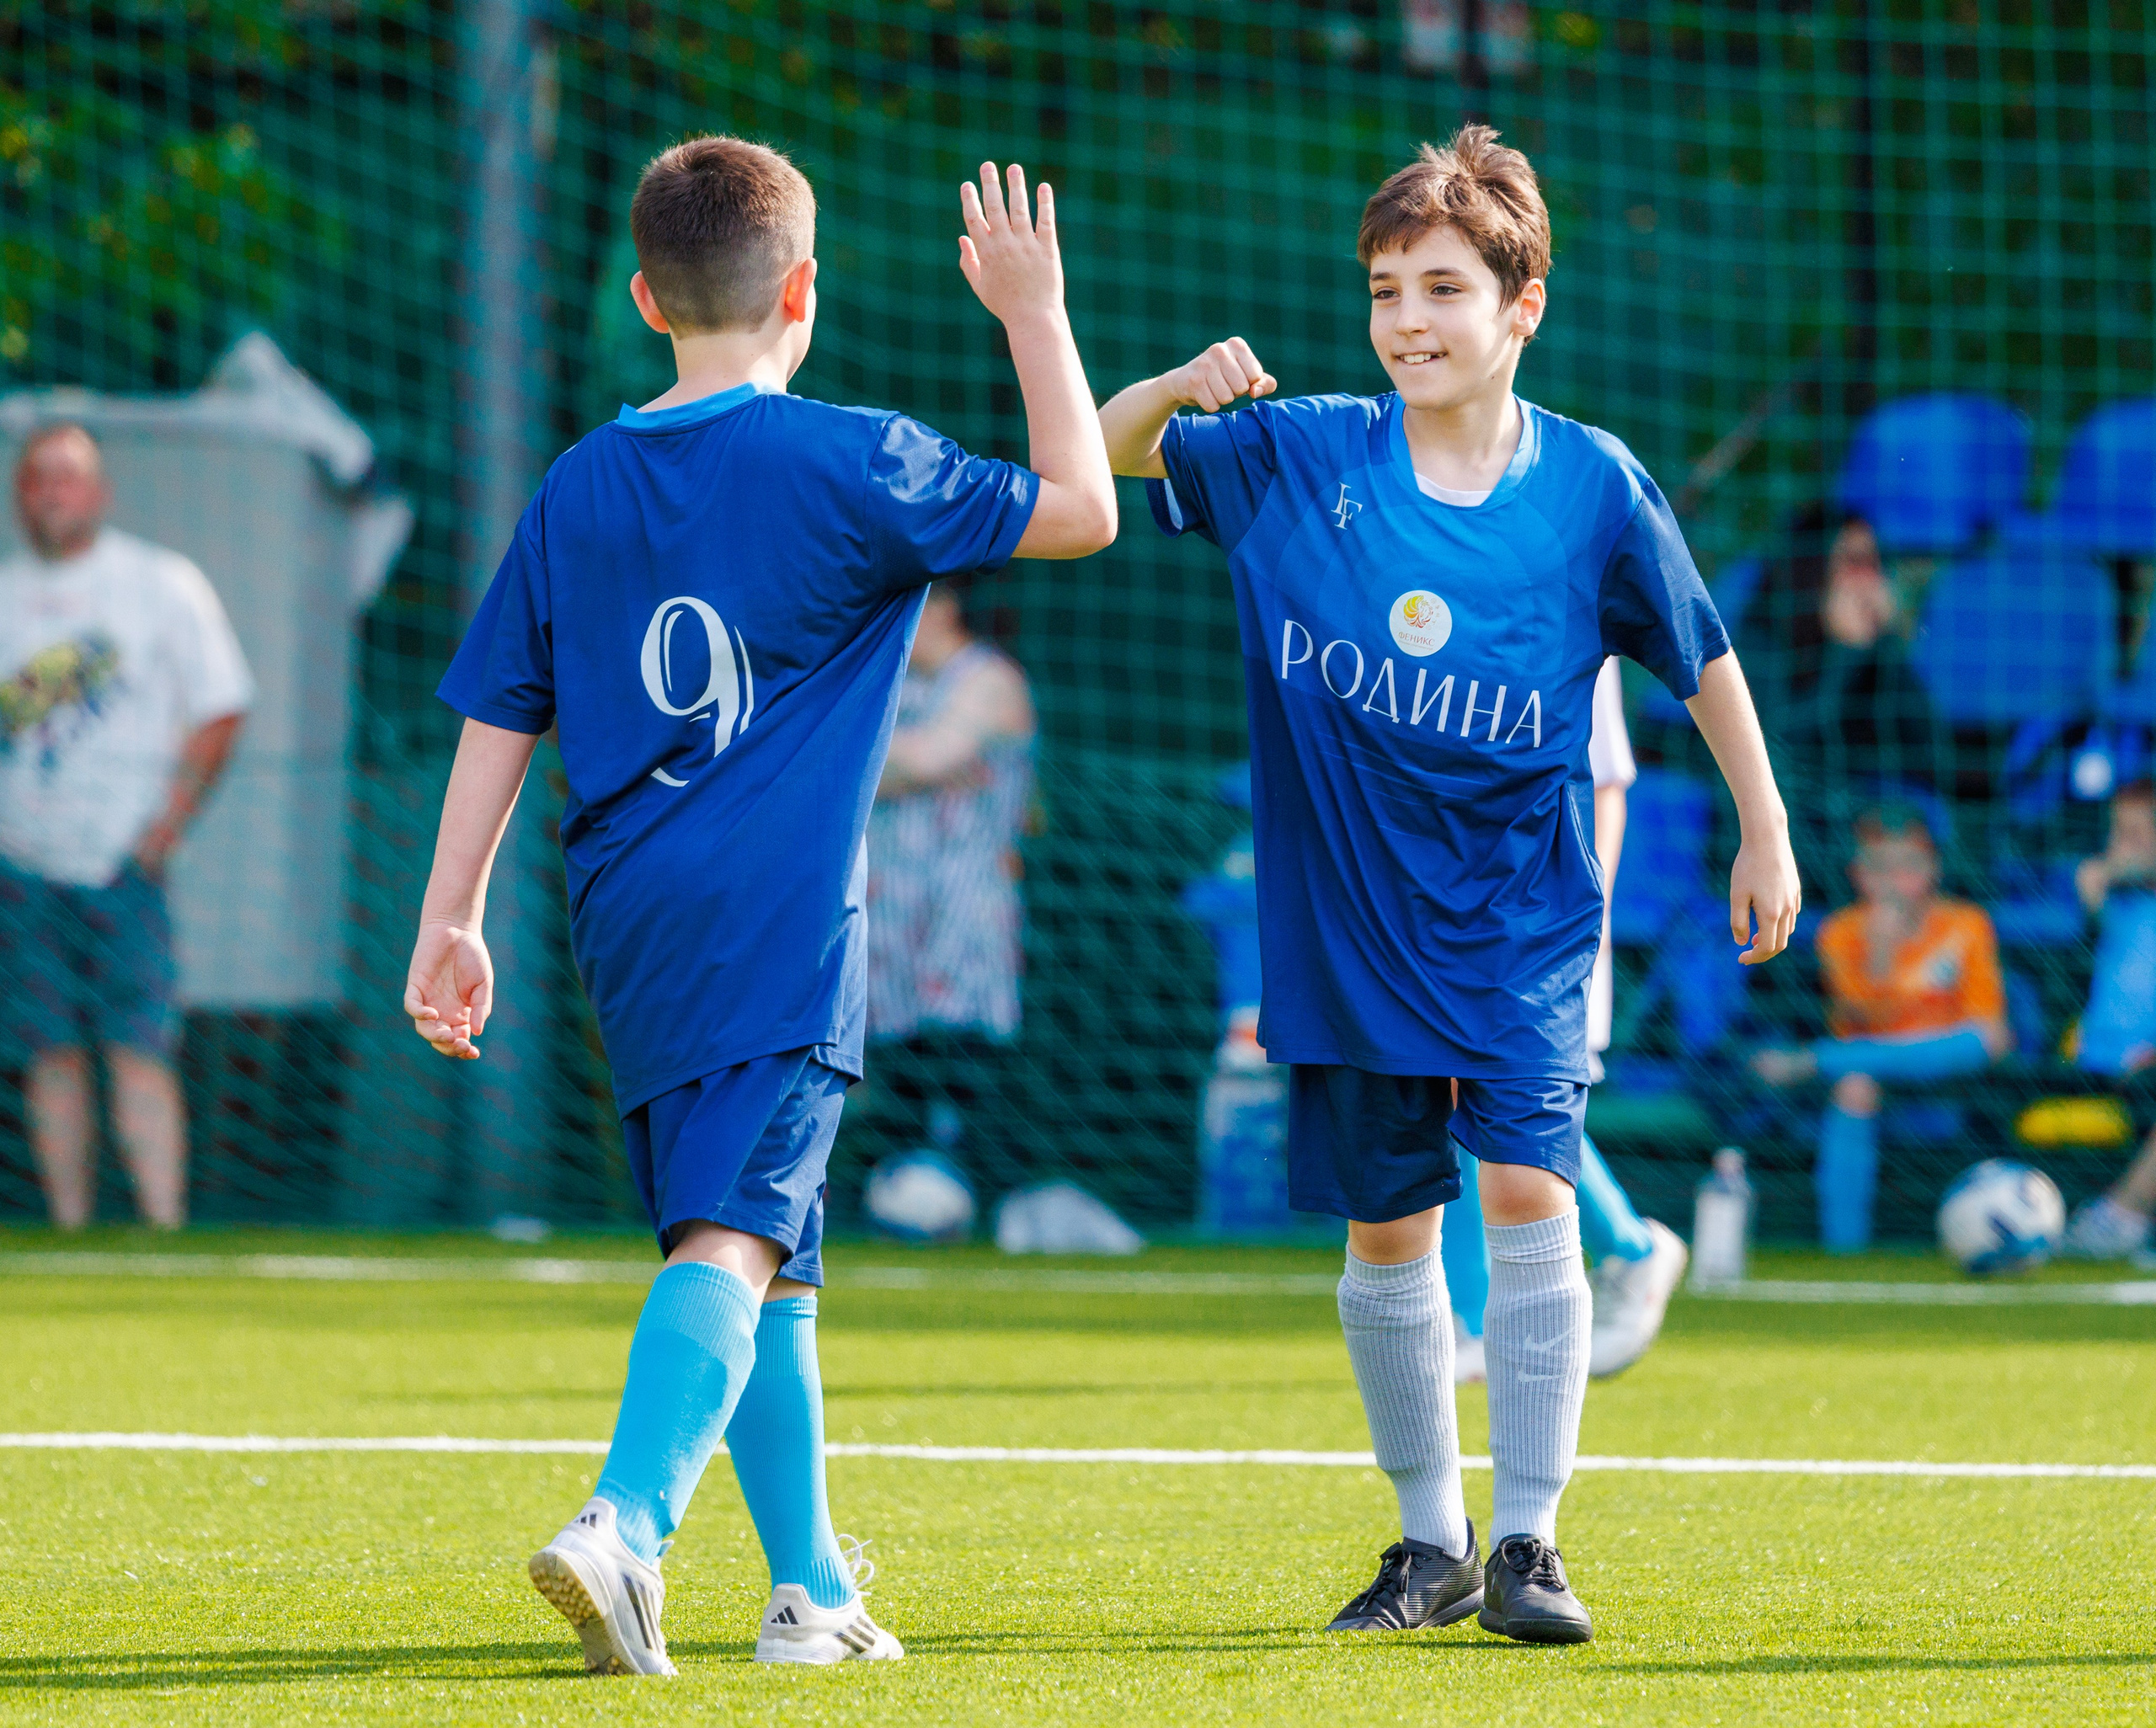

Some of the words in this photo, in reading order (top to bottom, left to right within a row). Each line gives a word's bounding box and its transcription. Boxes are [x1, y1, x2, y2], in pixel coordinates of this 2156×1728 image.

[640, 595, 755, 787] 9
[1281, 619, 1541, 748] РОДИНА
[1398, 632, 1435, 647] ФЕНИКС
